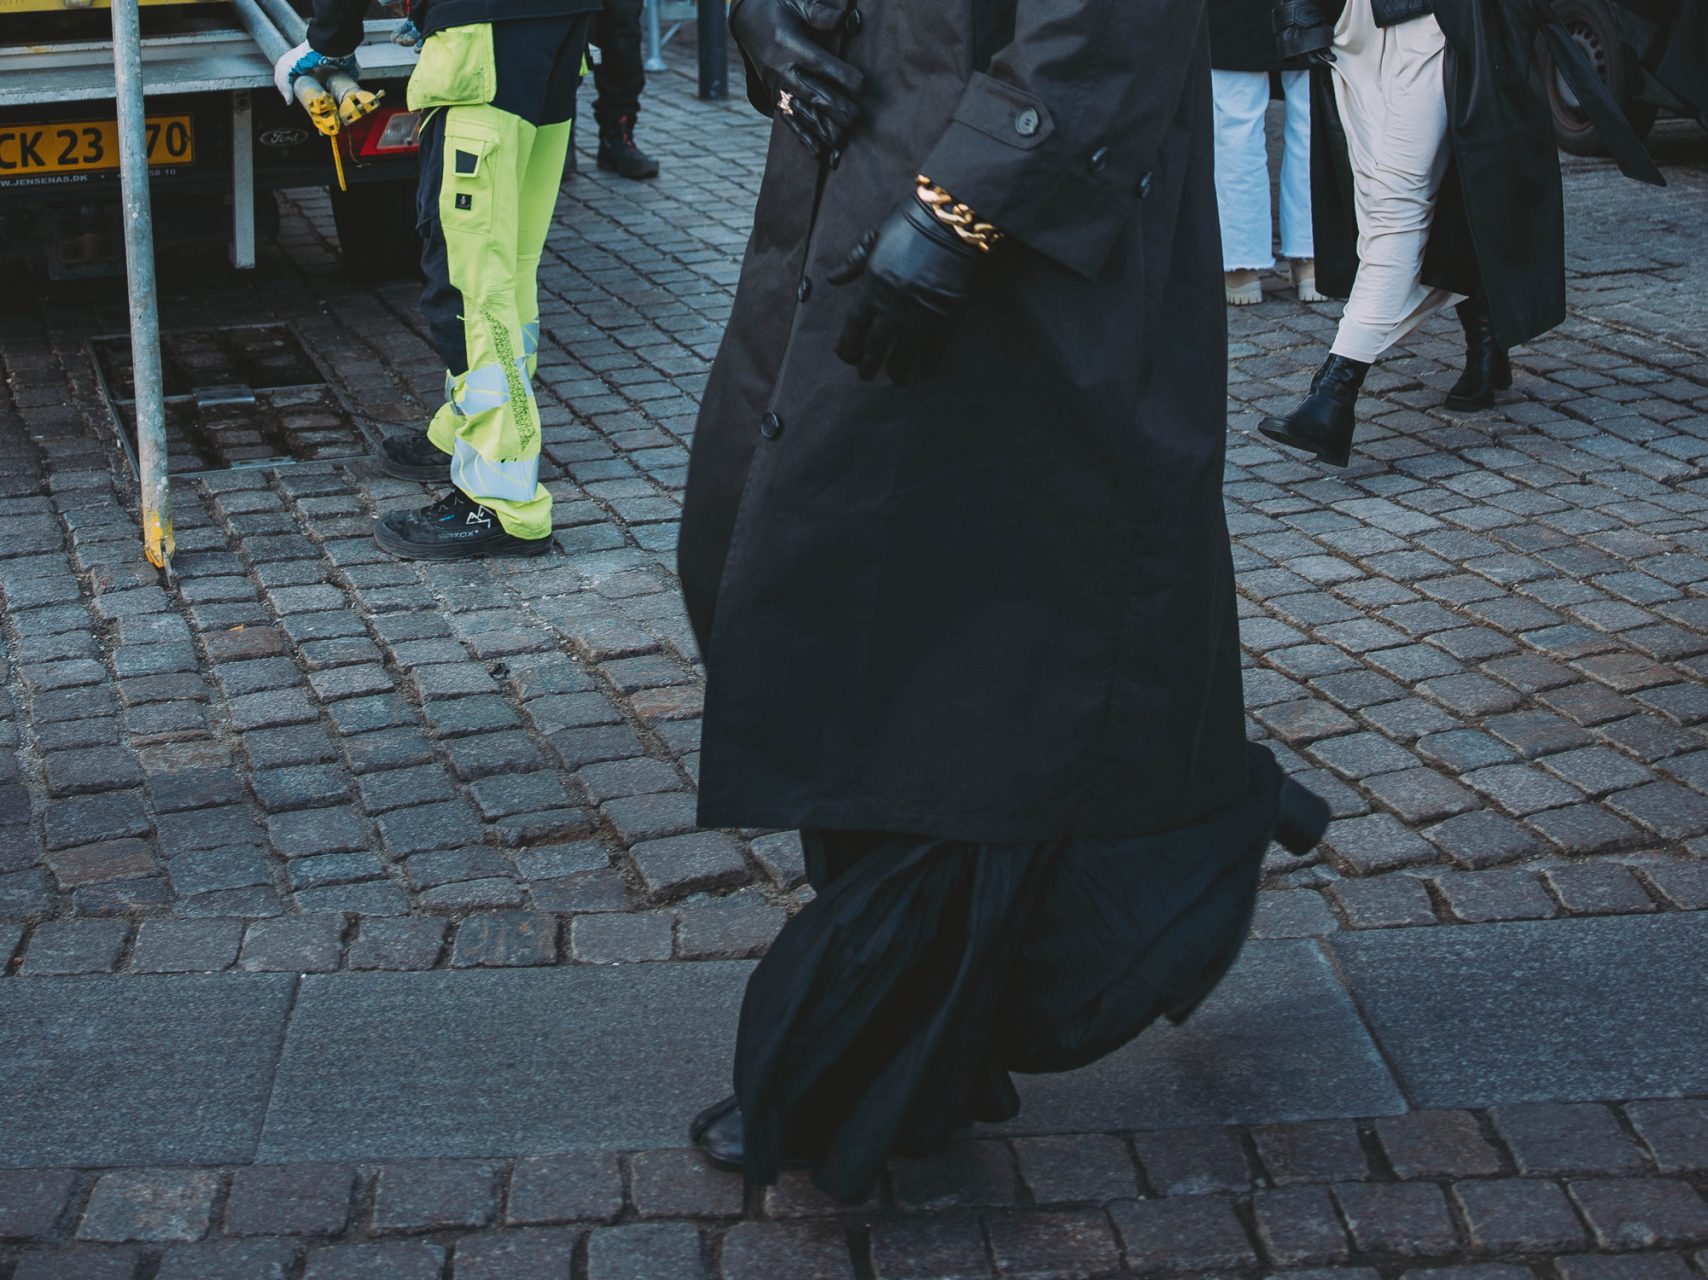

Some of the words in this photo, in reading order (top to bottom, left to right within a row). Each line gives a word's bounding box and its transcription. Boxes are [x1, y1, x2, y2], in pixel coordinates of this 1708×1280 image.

[0, 131, 46, 169] CK
[56, 127, 104, 165] 23
[145, 121, 188, 159] 70
[271, 130, 298, 144] Ford
